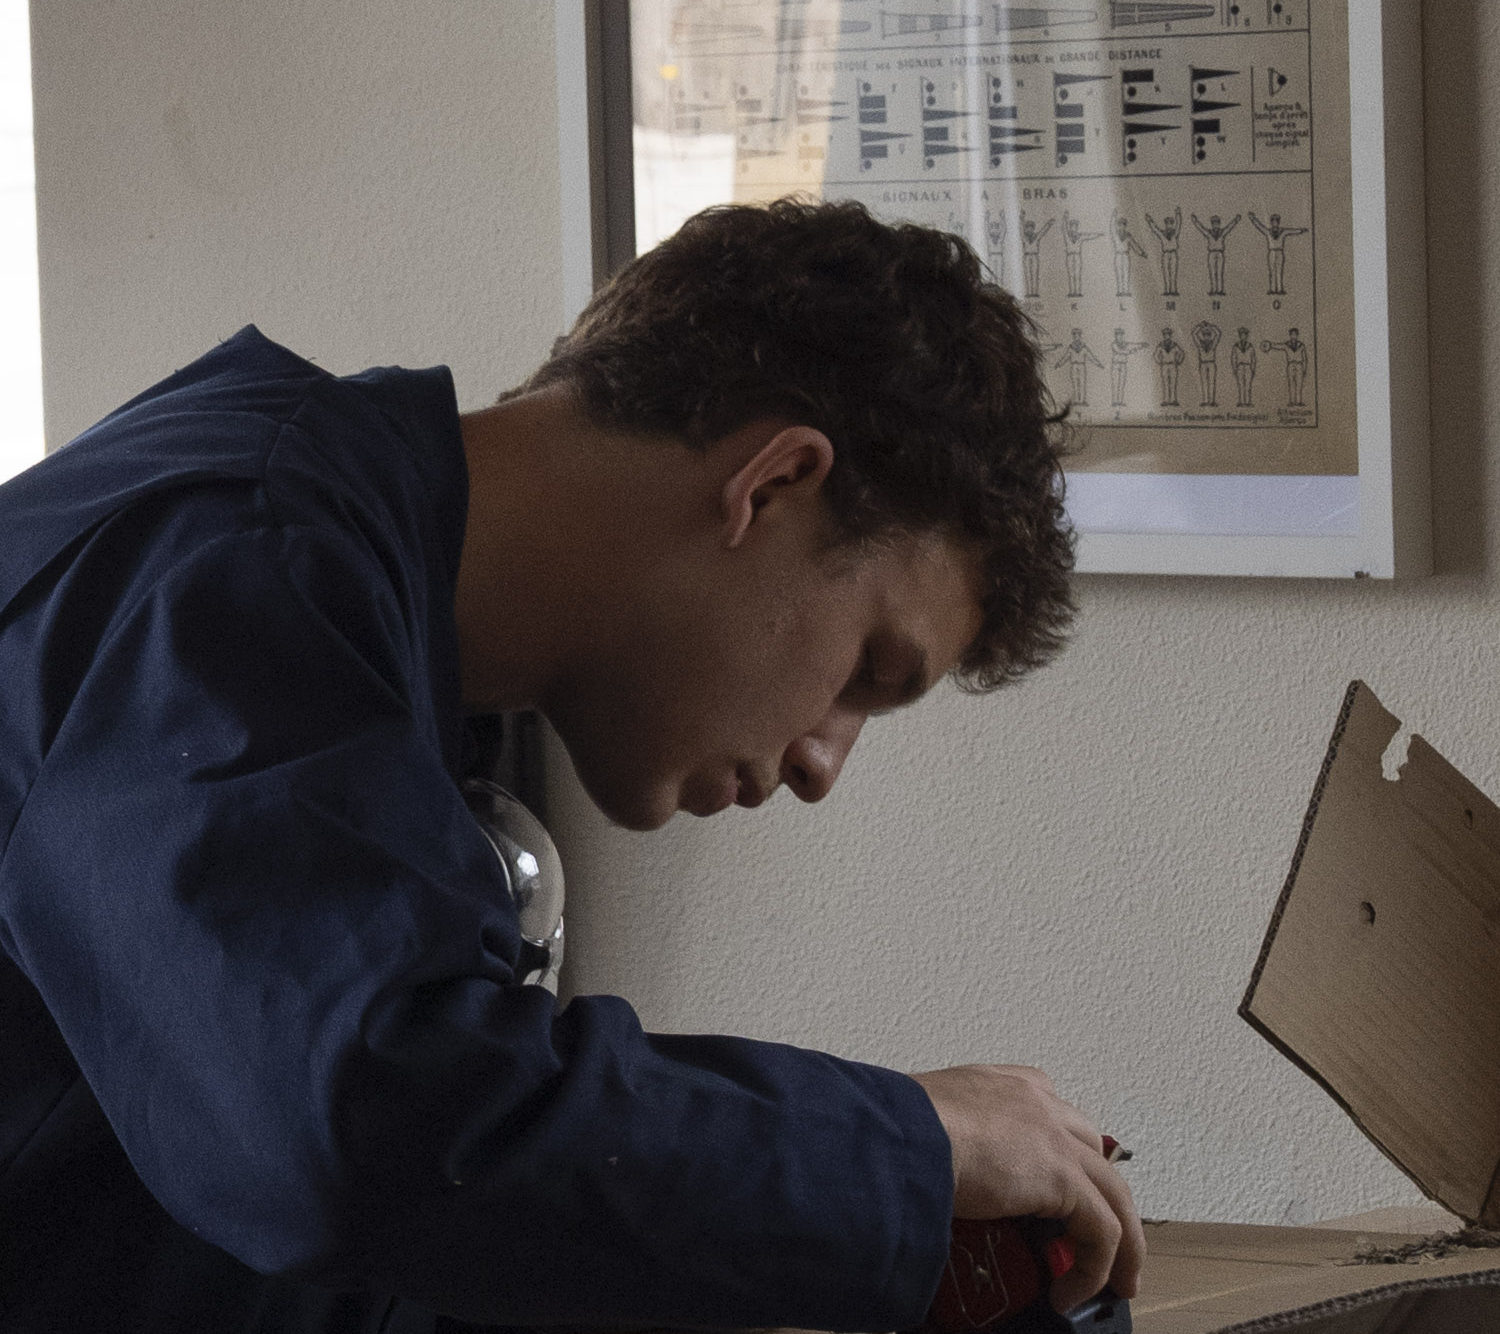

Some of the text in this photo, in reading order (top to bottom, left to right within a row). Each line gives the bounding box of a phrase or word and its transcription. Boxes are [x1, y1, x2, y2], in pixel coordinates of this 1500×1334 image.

[1023, 187, 1068, 202] BRAS
[1165, 301, 1176, 311] M
[1212, 301, 1221, 311] N
